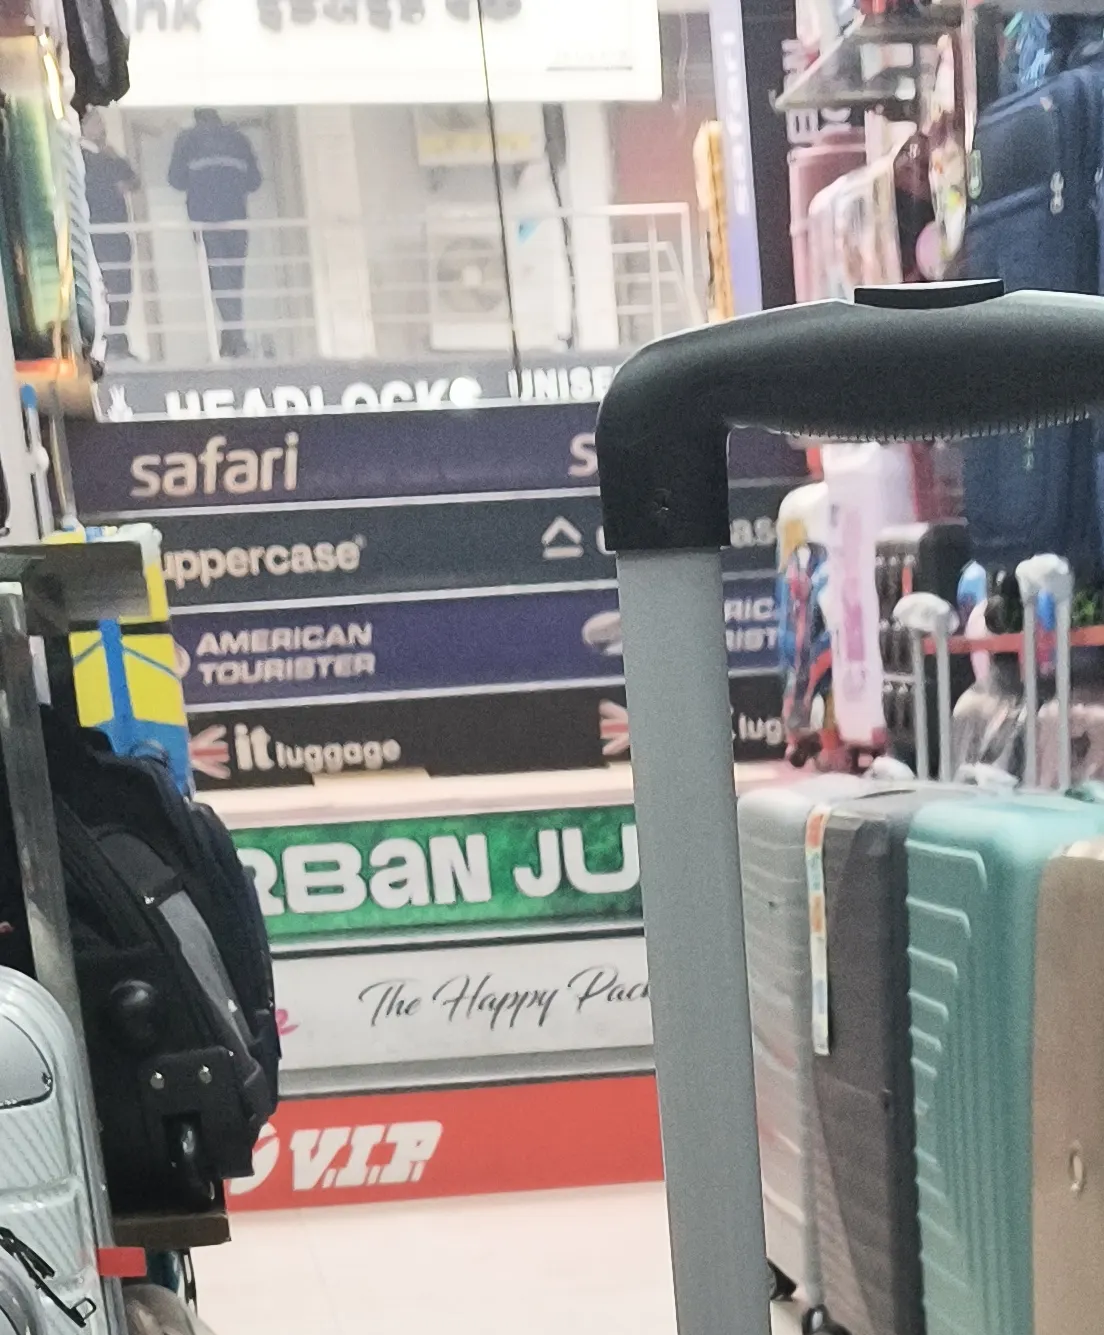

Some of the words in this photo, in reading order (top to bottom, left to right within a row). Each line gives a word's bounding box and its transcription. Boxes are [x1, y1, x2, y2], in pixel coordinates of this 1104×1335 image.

[507, 366, 621, 400] UNISE
[130, 432, 298, 498] safari
[196, 622, 374, 656] AMERICAN
[198, 652, 376, 687] TOURISTER
[234, 722, 275, 771] it
[275, 738, 402, 773] luggage
[358, 977, 422, 1027] The
[432, 973, 559, 1031] Happy
[567, 963, 650, 1014] Pac
